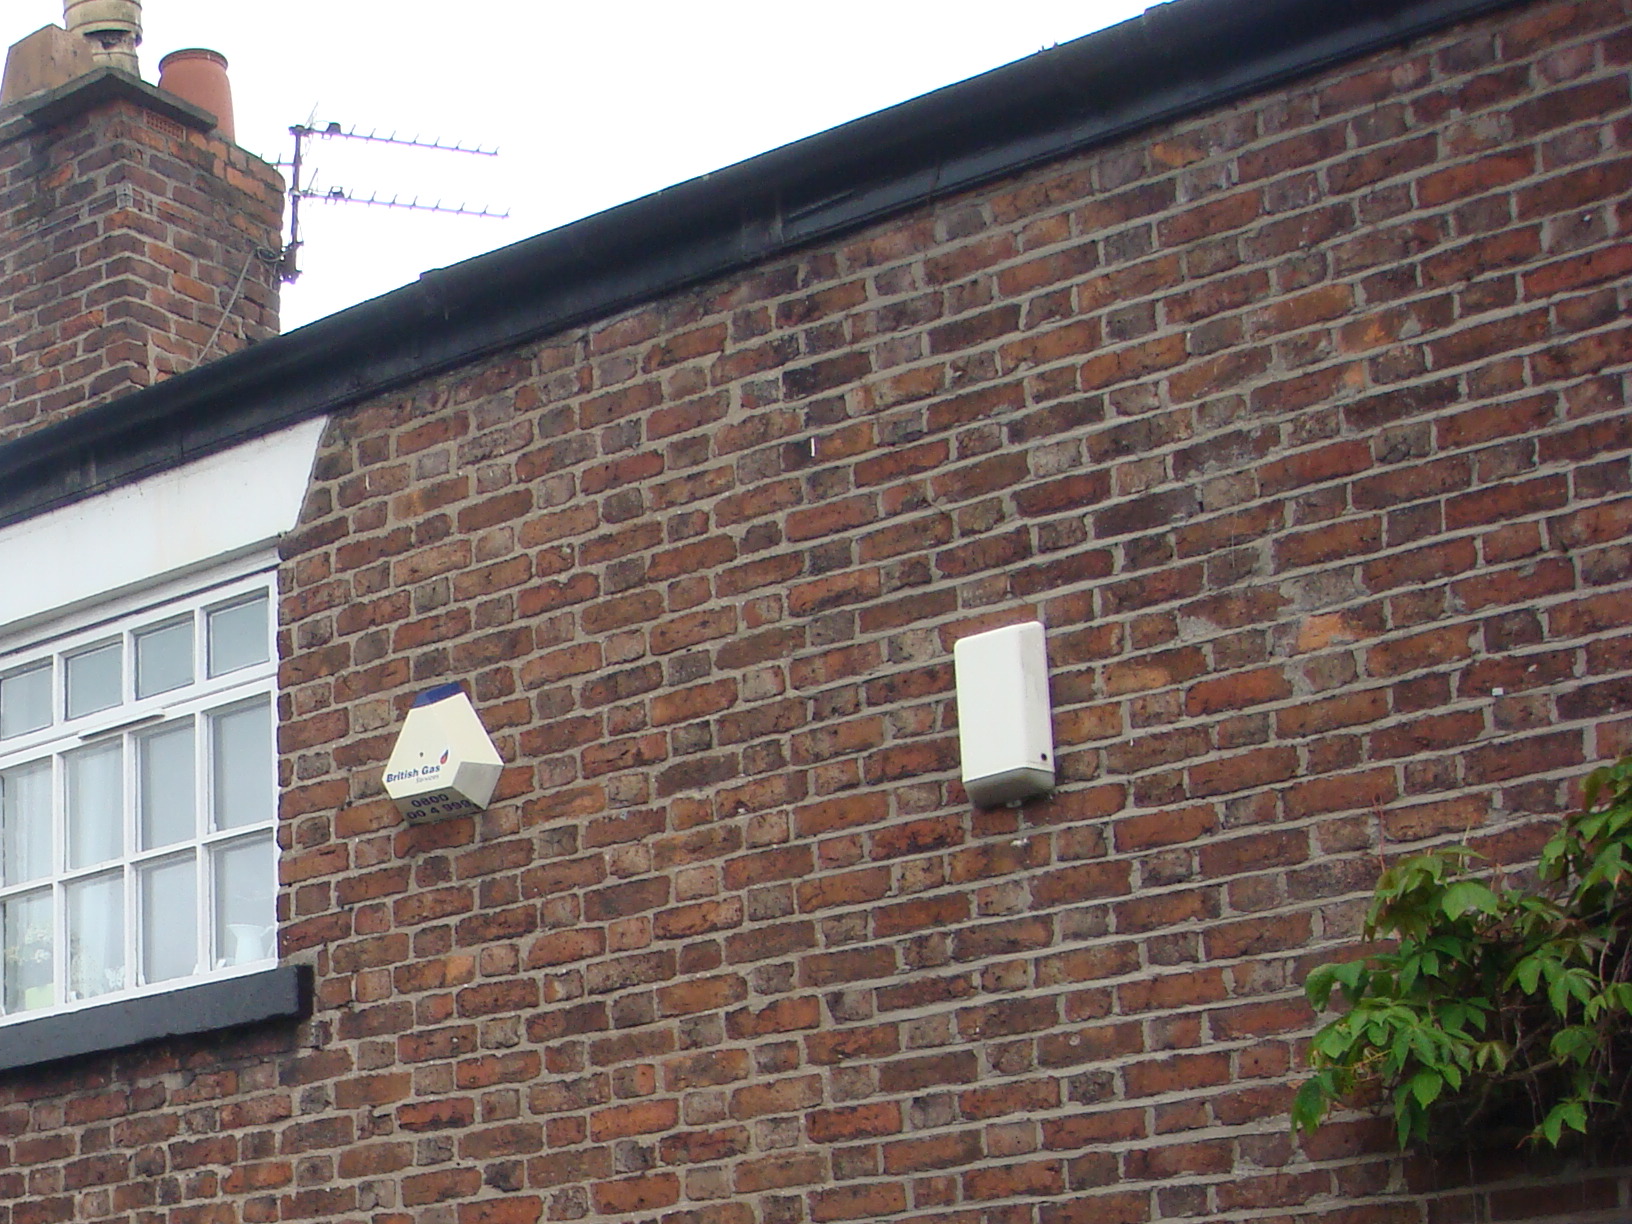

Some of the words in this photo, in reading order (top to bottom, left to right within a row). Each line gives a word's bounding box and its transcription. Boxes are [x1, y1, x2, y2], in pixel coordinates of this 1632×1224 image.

[386, 768, 419, 783] British
[421, 765, 441, 775] Gas
[411, 793, 449, 808] 0800
